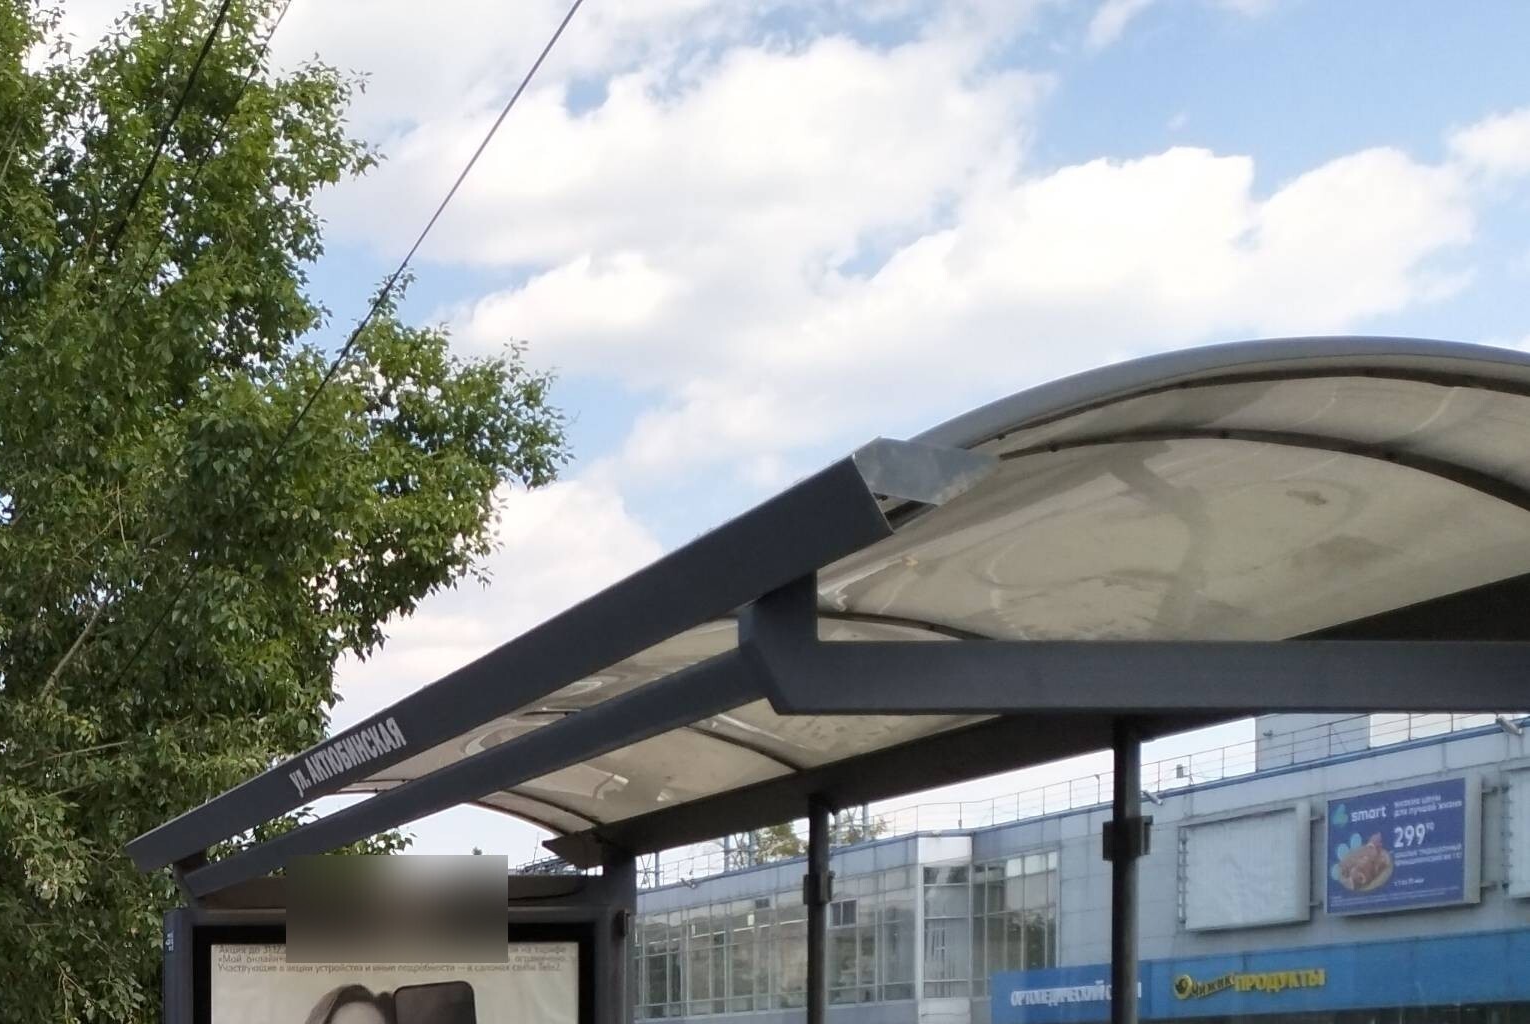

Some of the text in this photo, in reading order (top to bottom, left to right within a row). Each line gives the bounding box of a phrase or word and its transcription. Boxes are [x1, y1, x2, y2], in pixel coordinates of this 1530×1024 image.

[289, 717, 407, 798] ул. АКТЮБИНСКАЯ
[1350, 806, 1387, 822] smart
[1393, 823, 1426, 848] 299
[1234, 968, 1326, 994] ПРОДУКТЫ
